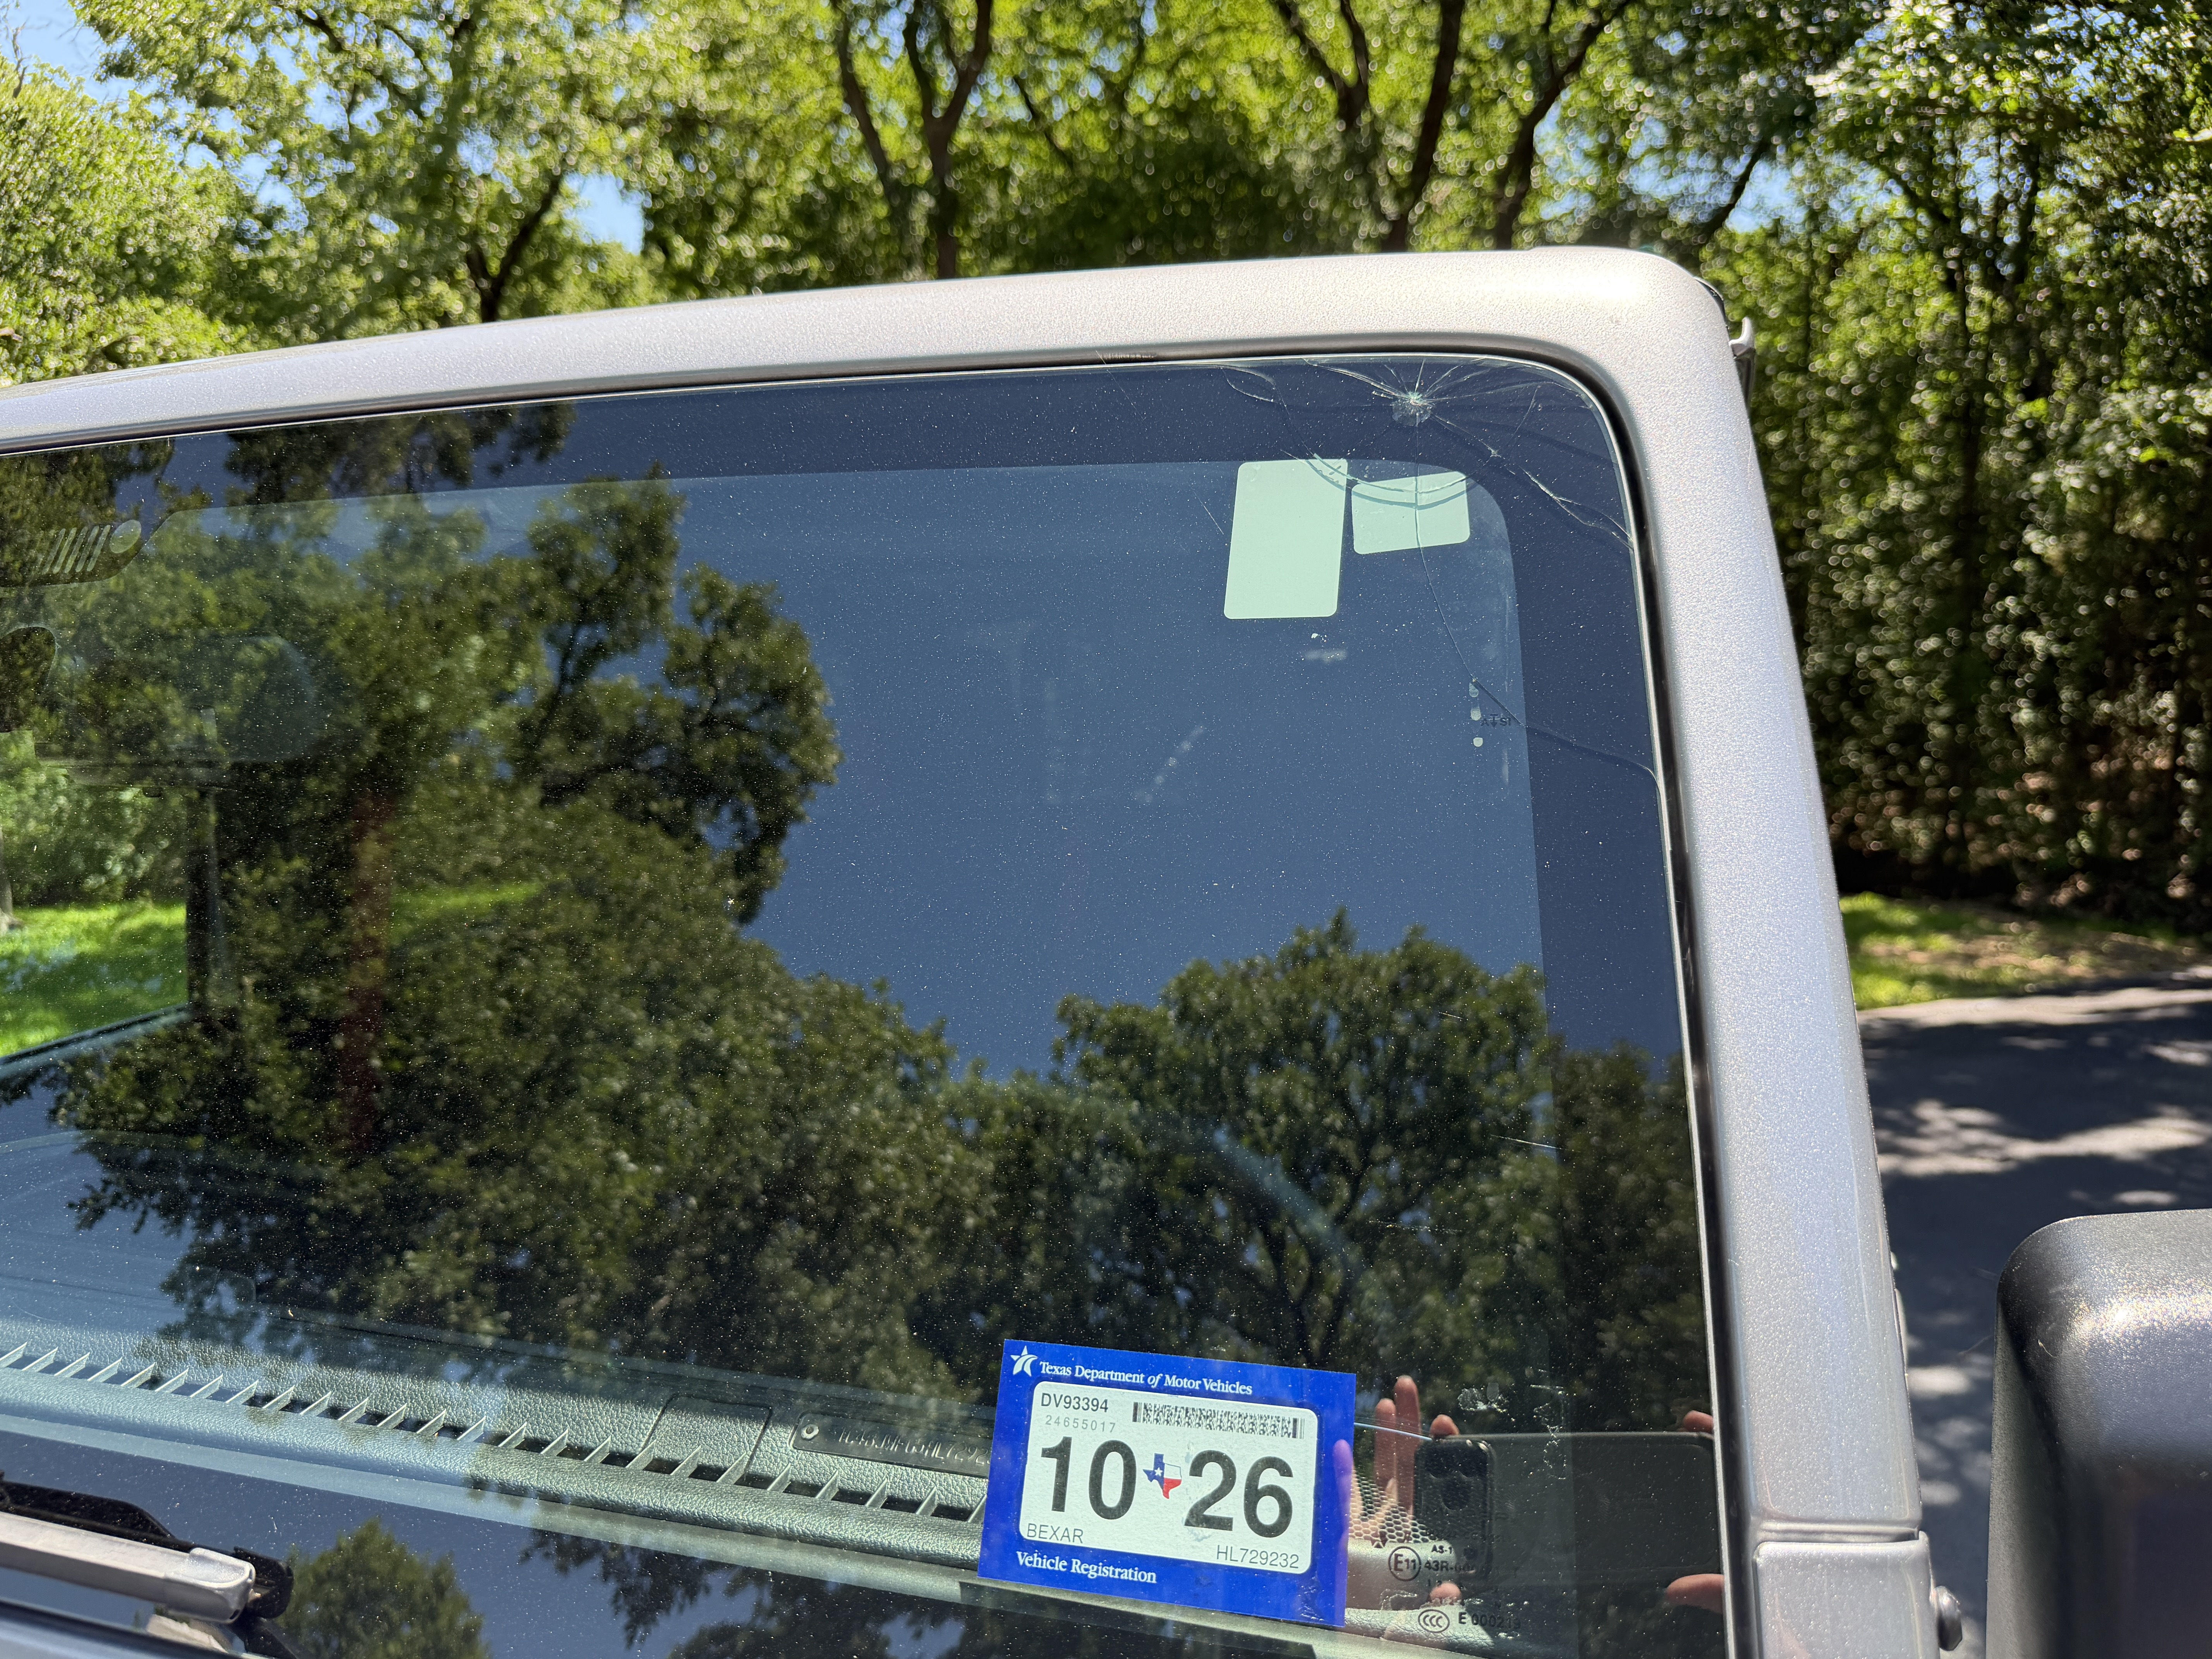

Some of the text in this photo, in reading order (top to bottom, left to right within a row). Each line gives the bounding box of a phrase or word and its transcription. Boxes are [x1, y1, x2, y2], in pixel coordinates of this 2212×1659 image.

[1039, 1362, 1252, 1395] Texas Department of Motor Vehicles
[1041, 1393, 1108, 1412] DV93394
[1046, 1415, 1115, 1432] 24655017
[1041, 1437, 1293, 1538] 10 26
[1027, 1523, 1083, 1543] BEXAR
[1217, 1545, 1298, 1568] HL729232
[1432, 1545, 1453, 1554] AS-1
[1017, 1551, 1156, 1583] Vehicle Registration
